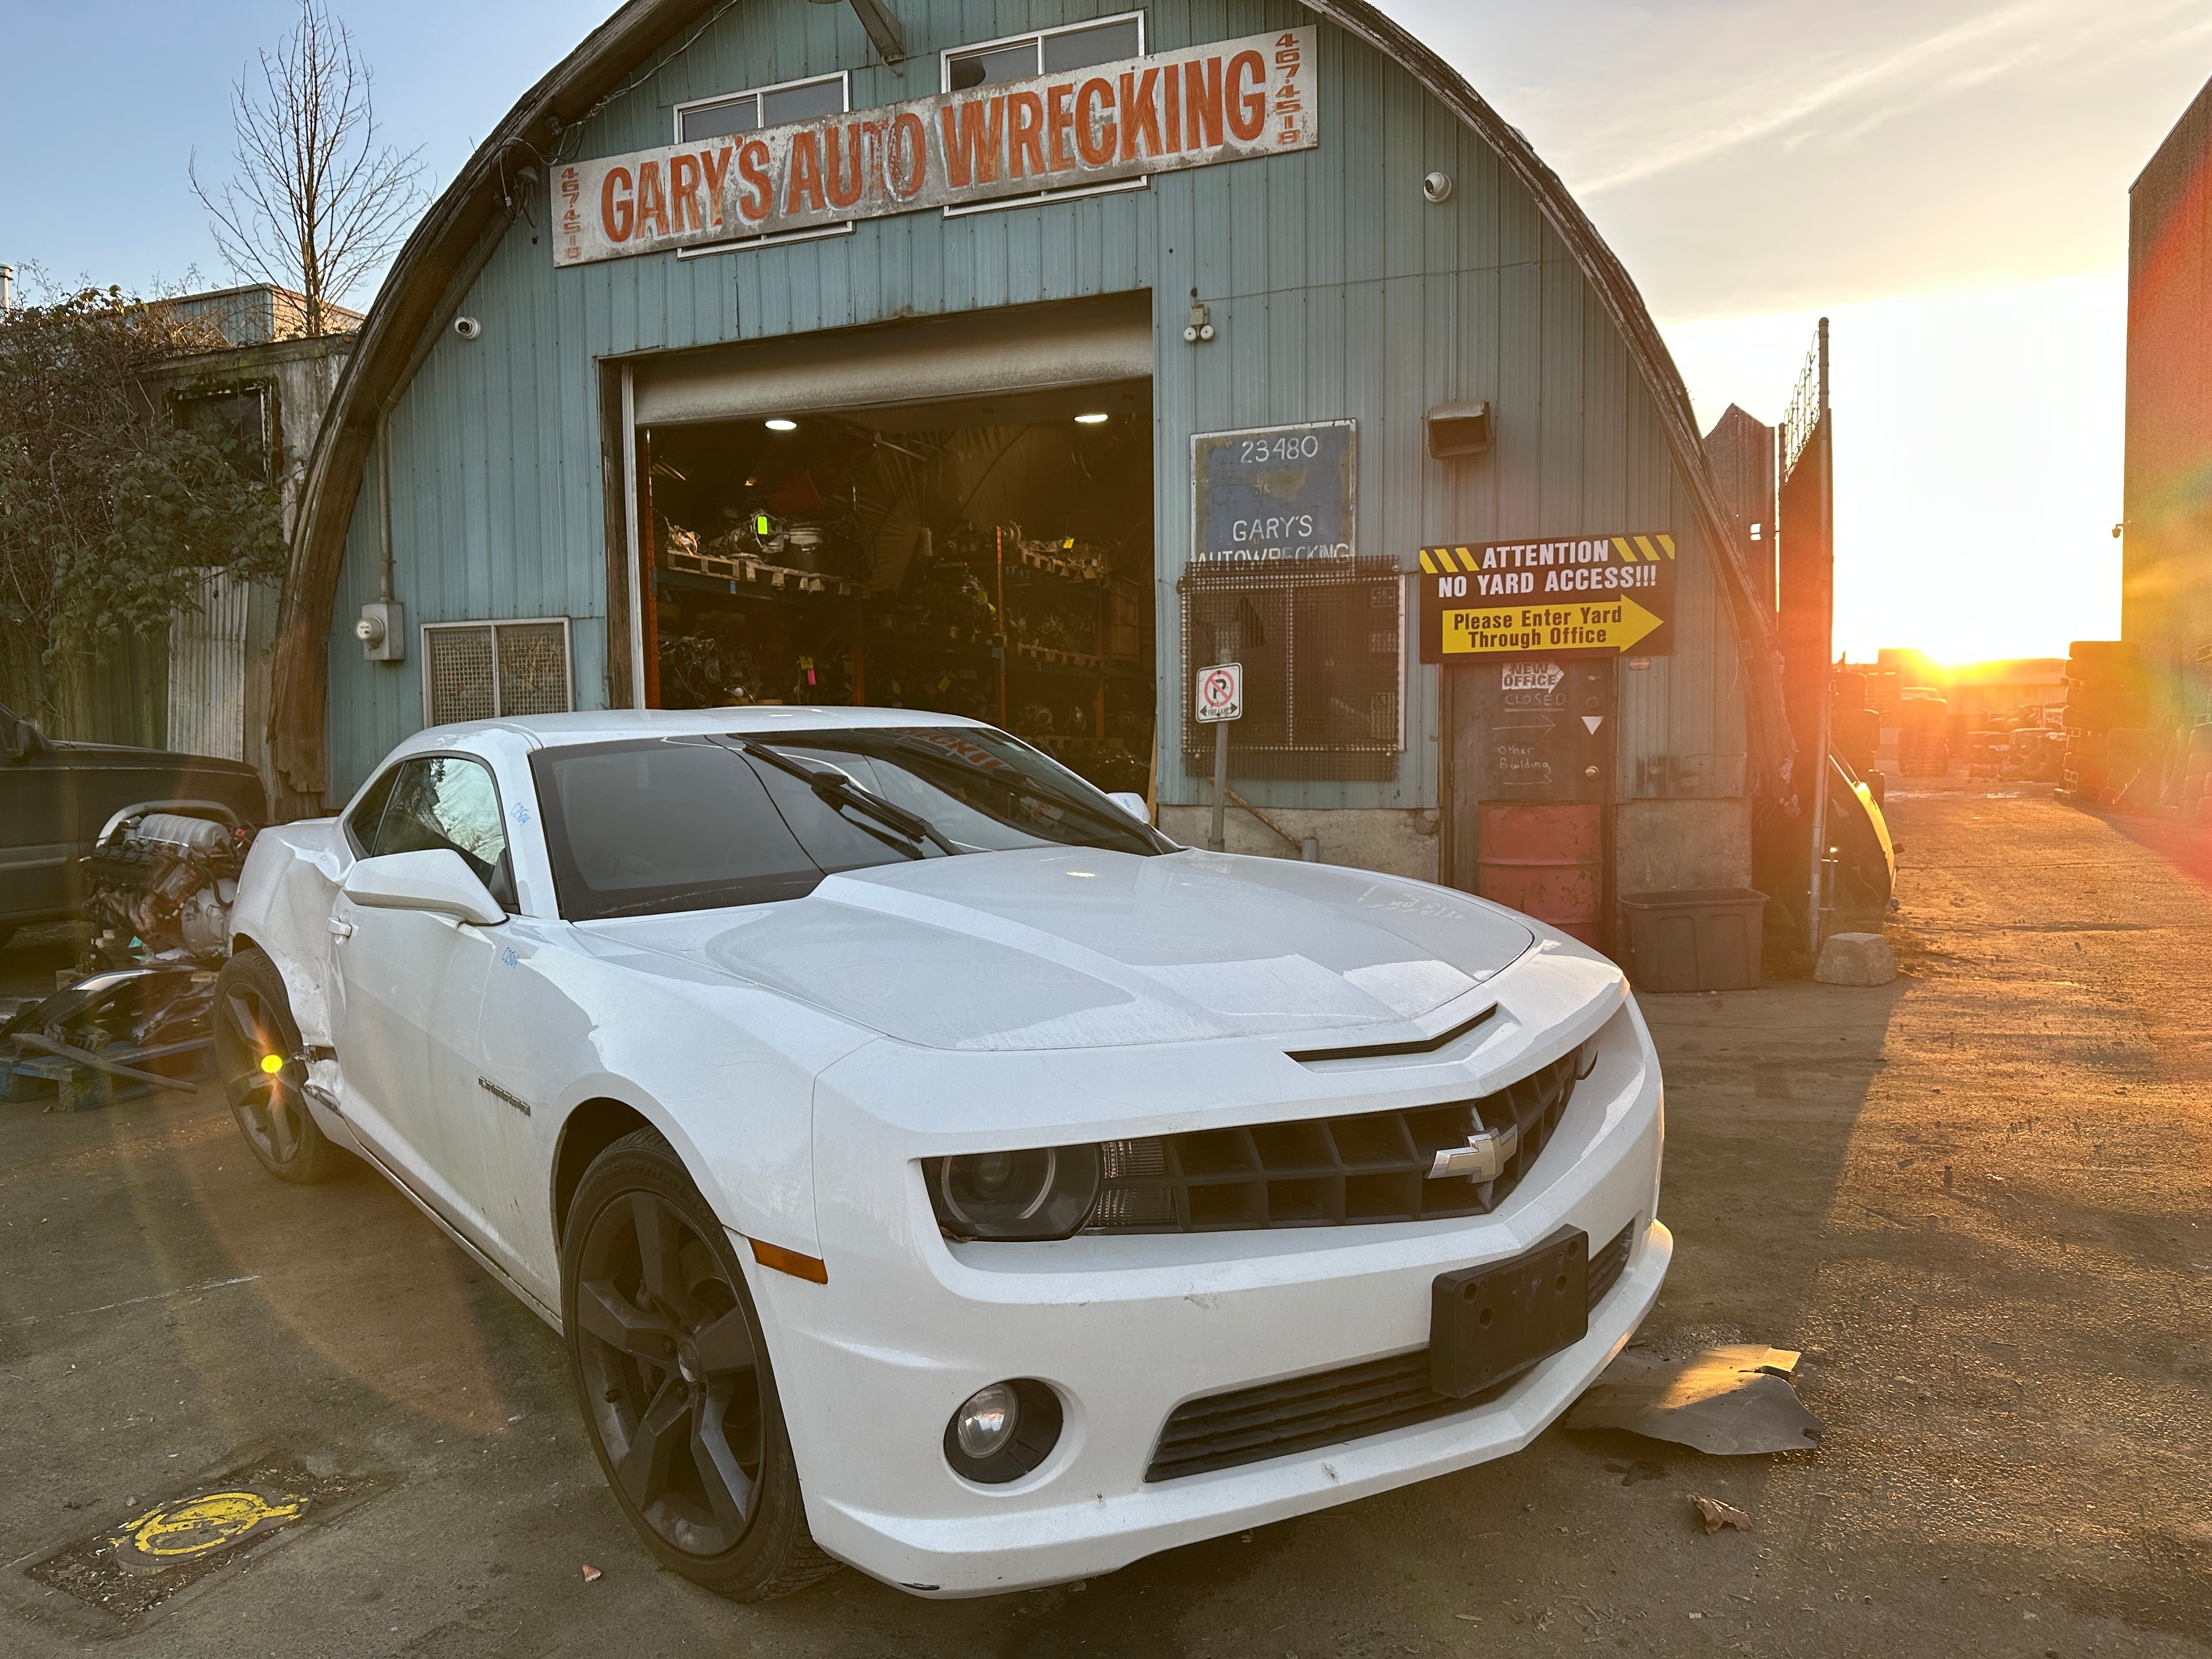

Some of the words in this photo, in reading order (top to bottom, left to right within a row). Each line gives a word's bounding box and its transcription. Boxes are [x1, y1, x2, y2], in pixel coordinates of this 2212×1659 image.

[599, 136, 772, 243] GARY'S
[786, 112, 926, 214] AUTO
[940, 50, 1266, 188] WRECKING
[1240, 435, 1319, 463] 23480
[1233, 515, 1313, 541] GARY'S
[1482, 540, 1609, 569] ATTENTION
[1438, 576, 1467, 598] NO
[1478, 572, 1534, 596] YARD
[1544, 565, 1657, 593] ACCESS!!!
[1454, 613, 1513, 630] Please
[1521, 609, 1571, 627] Enter
[1580, 605, 1622, 624] Yard
[1468, 629, 1541, 649] Through
[1550, 627, 1607, 645] Office
[1504, 674, 1556, 687] OFFICE
[1511, 663, 1548, 675] NEW
[1505, 693, 1566, 706] CLOSED
[1499, 757, 1551, 775] Building
